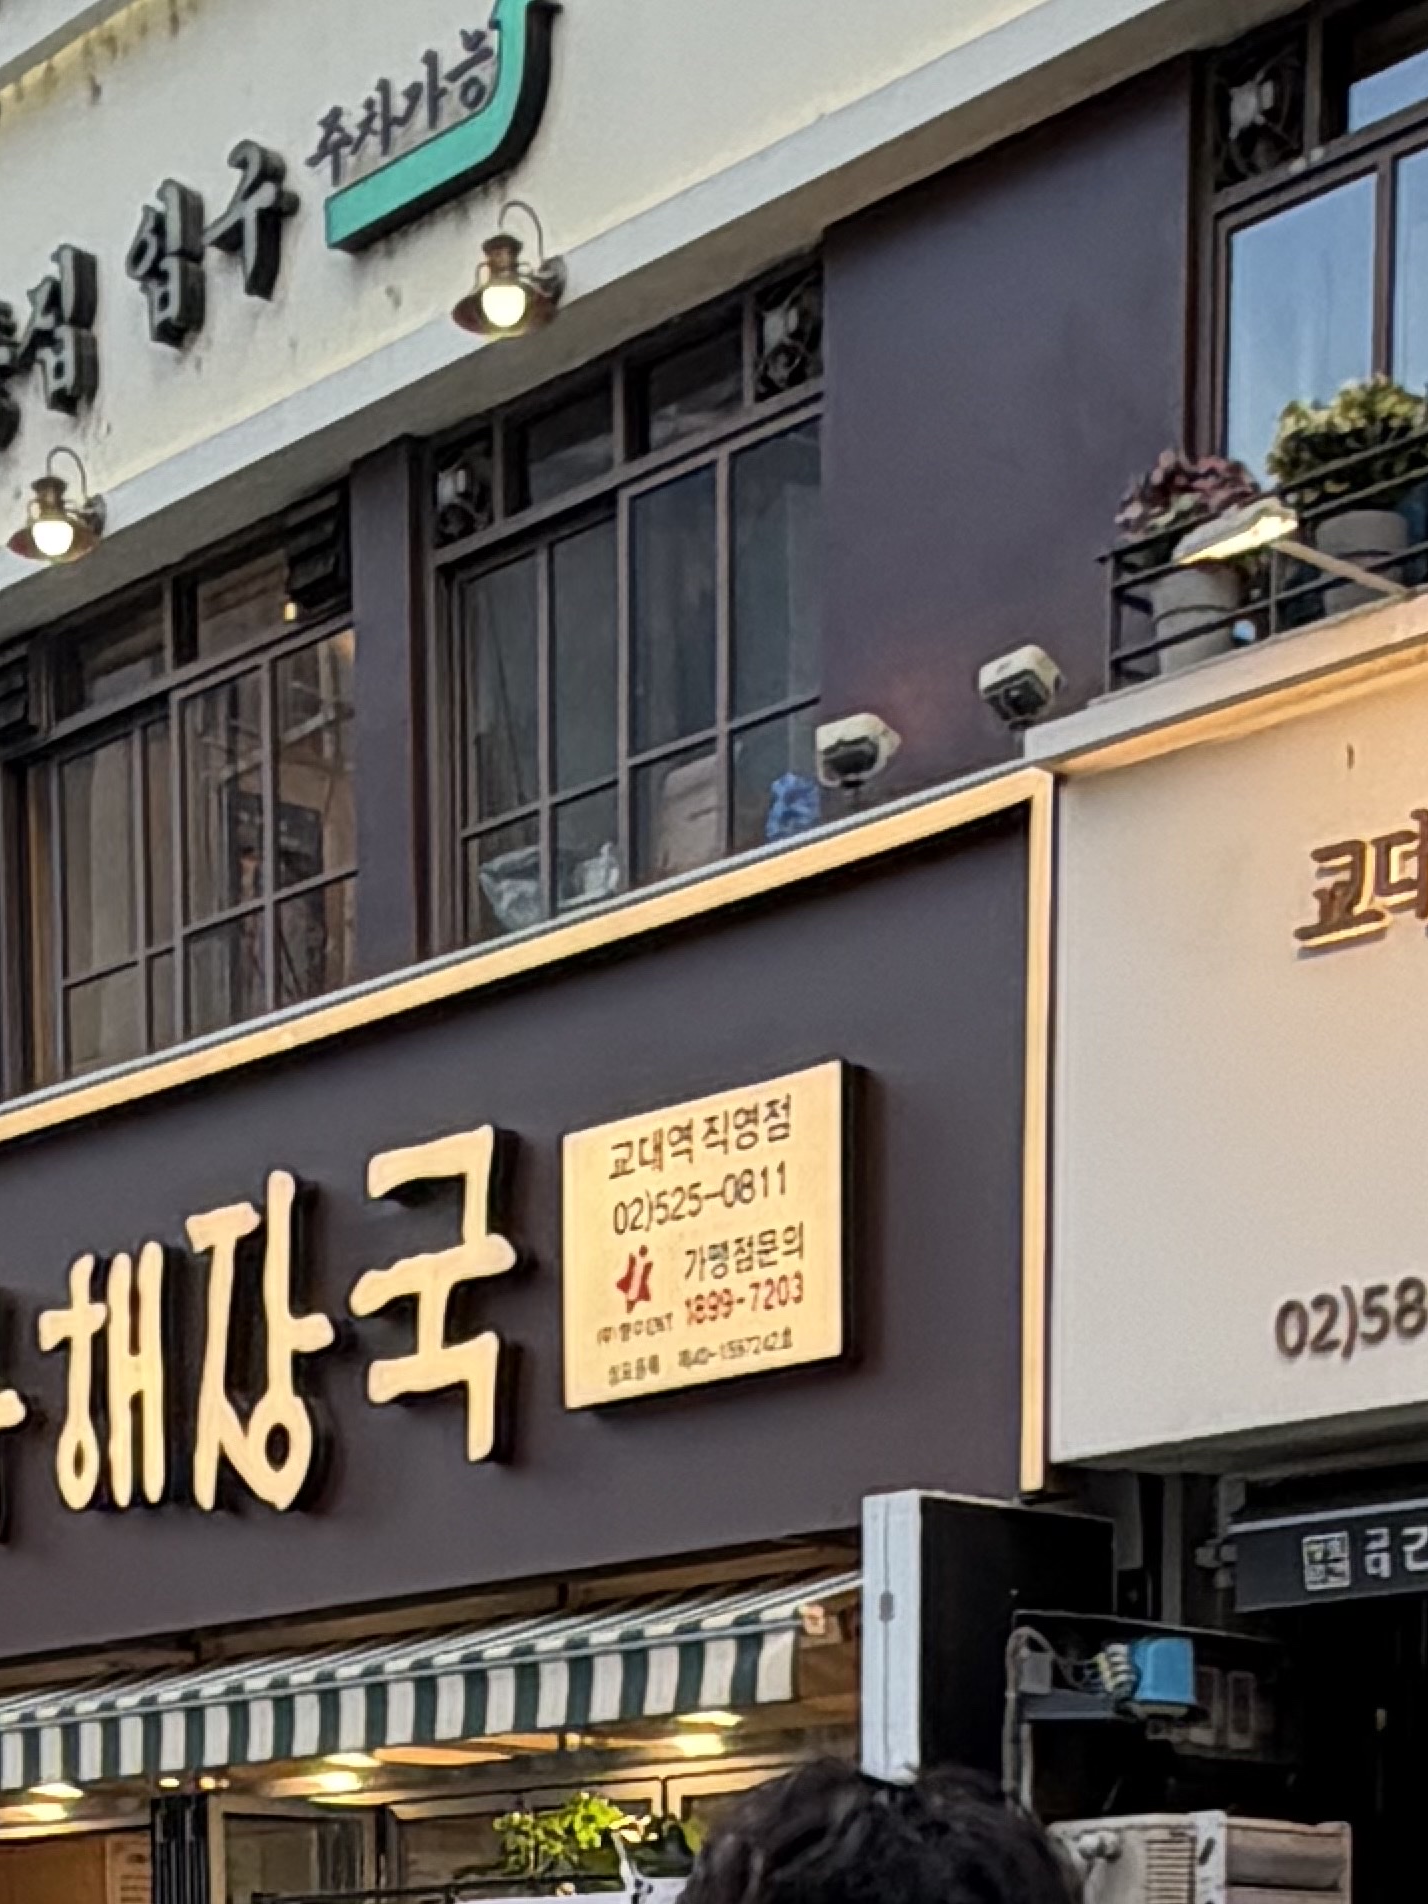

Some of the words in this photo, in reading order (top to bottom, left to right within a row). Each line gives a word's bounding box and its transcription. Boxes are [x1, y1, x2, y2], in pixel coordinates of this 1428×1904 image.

[303, 27, 494, 188] 주차가능
[125, 138, 300, 350] 입구
[608, 1117, 694, 1181] 교대역
[701, 1092, 792, 1156] 직영점
[612, 1159, 787, 1236] 02)525-0811
[684, 1269, 805, 1326] 1899-7203
